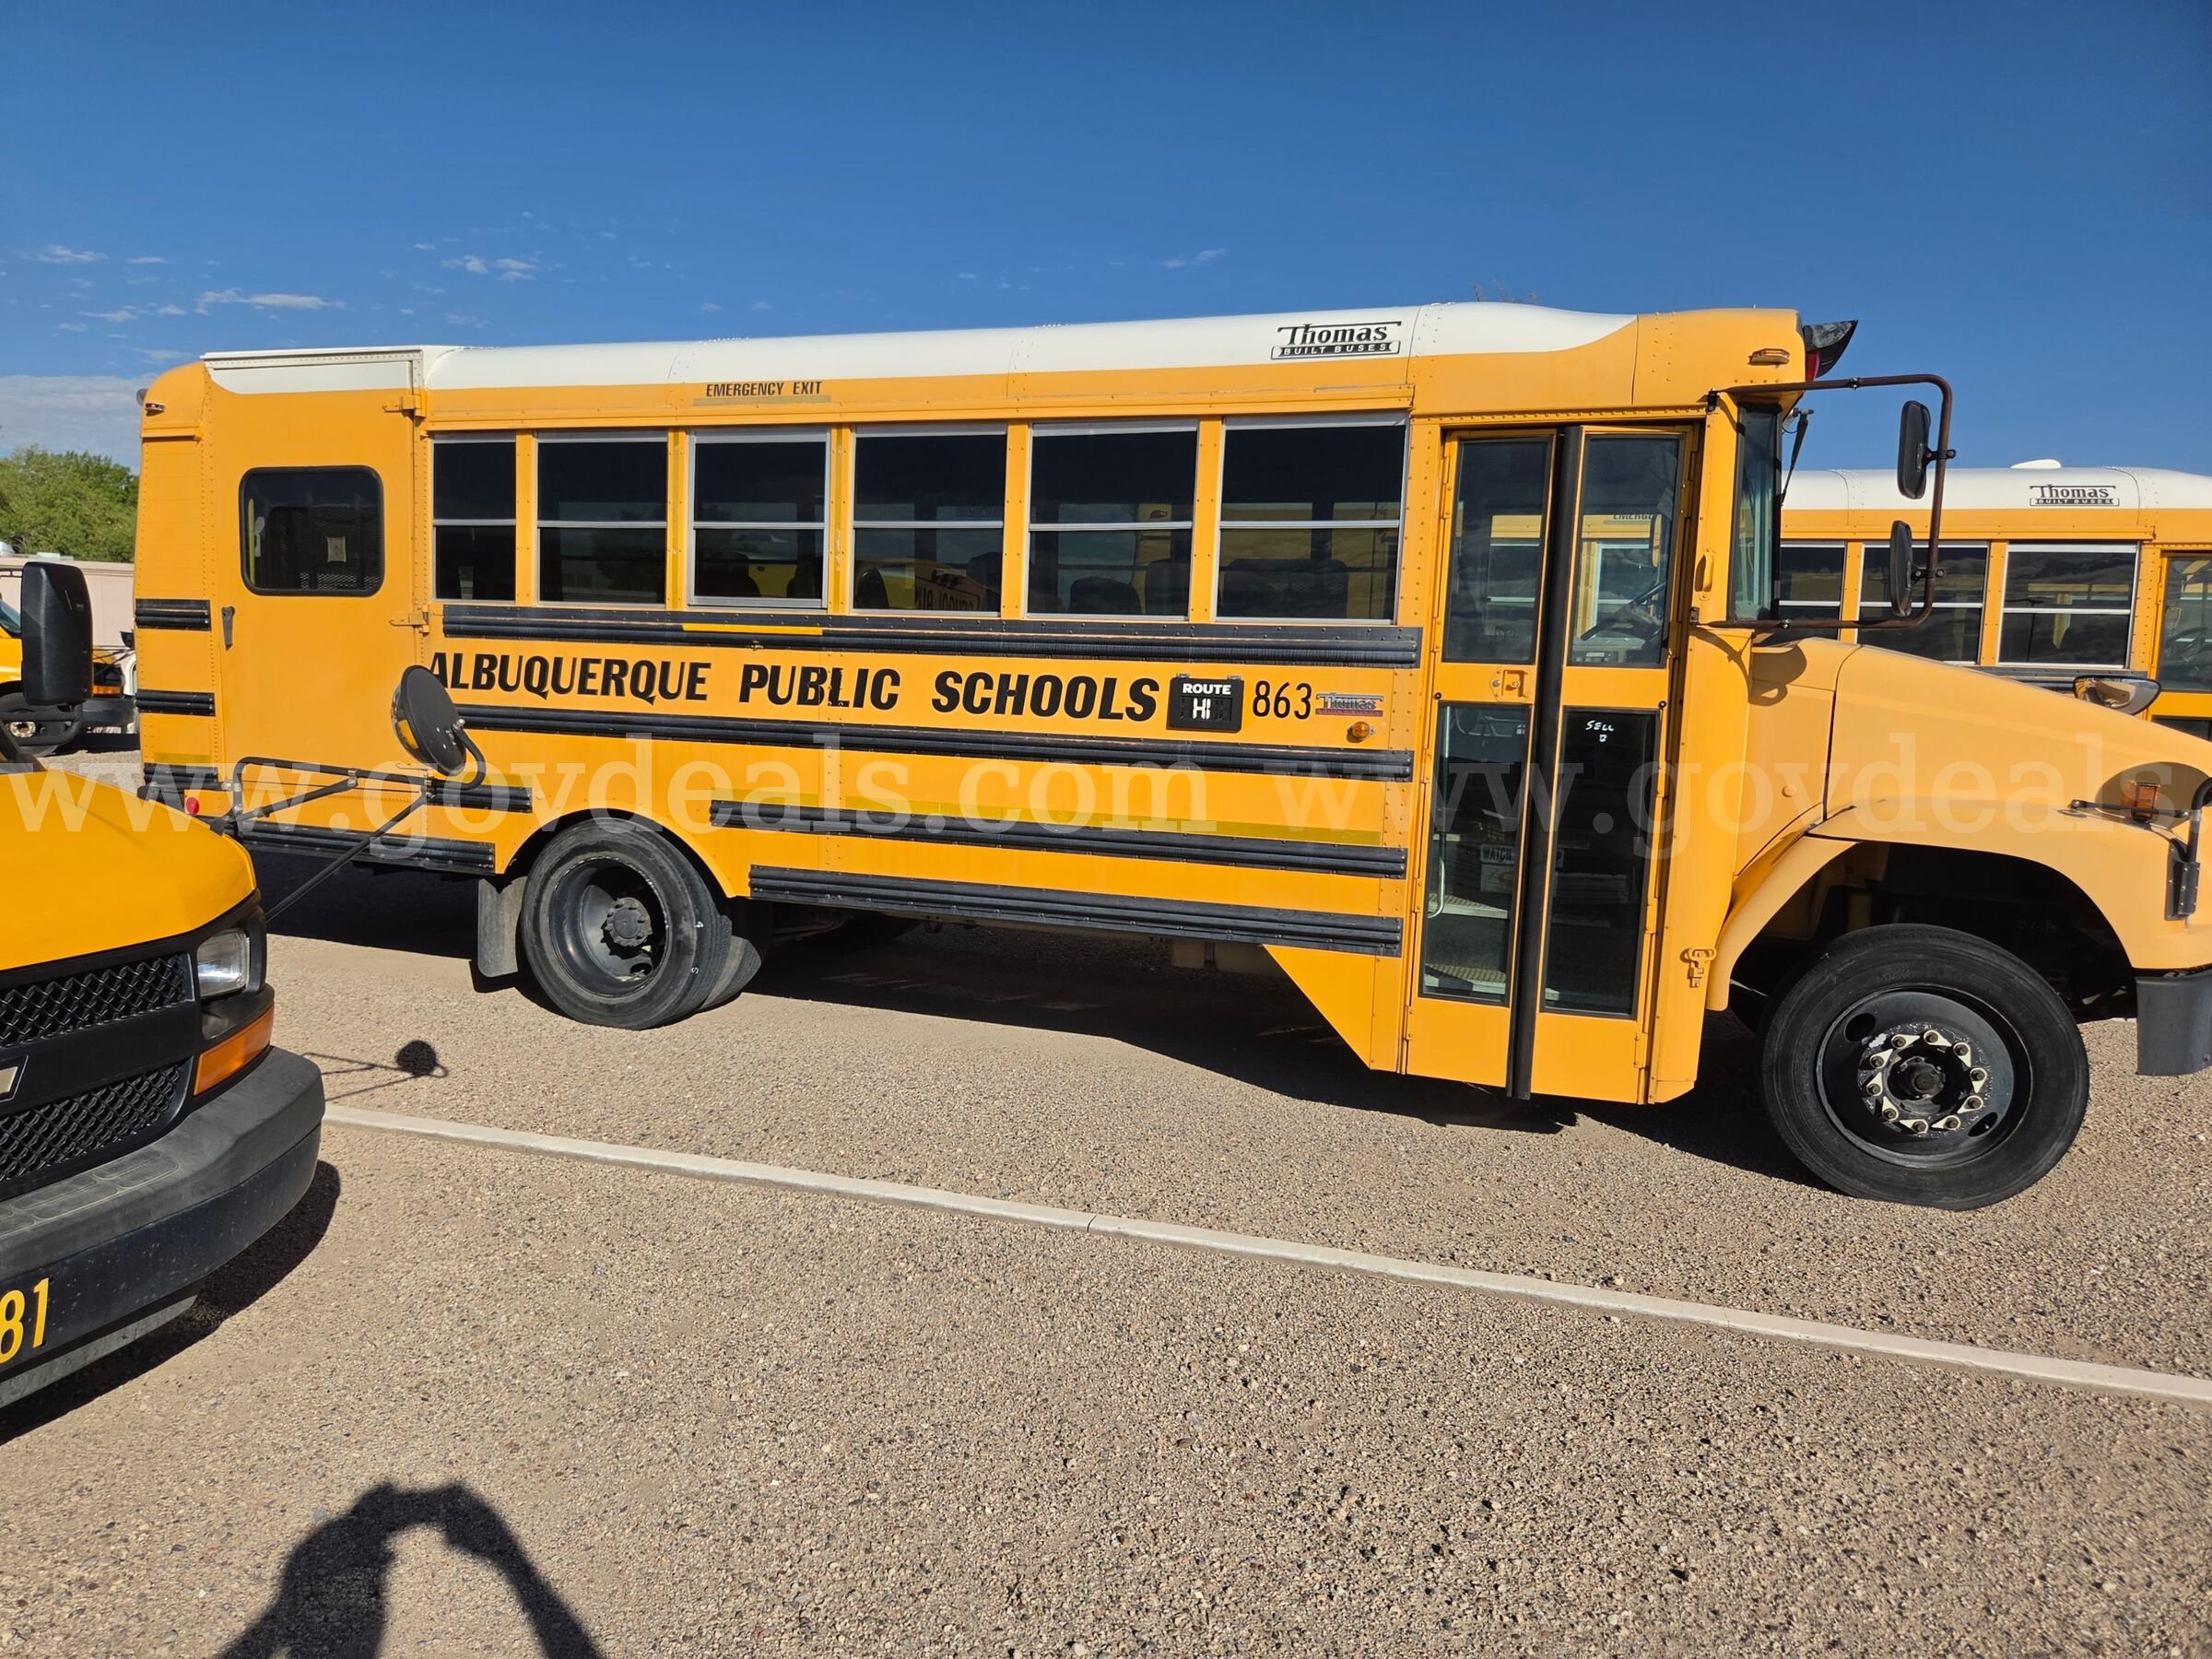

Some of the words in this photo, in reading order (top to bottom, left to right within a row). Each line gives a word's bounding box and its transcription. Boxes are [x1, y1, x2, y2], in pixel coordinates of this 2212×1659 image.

[1277, 321, 1402, 345] Thomas
[1284, 346, 1326, 356] BUILT
[1334, 343, 1387, 353] BUSES
[706, 382, 784, 397] EMERGENCY
[793, 381, 823, 394] EXIT
[2030, 484, 2116, 498] Thomas
[430, 652, 712, 705] ALBUQUERQUE
[739, 663, 900, 710] PUBLIC
[932, 669, 1159, 722] SCHOOLS
[1182, 683, 1231, 695] ROUTE
[1253, 680, 1312, 720] 863
[1585, 720, 1615, 732] SELL
